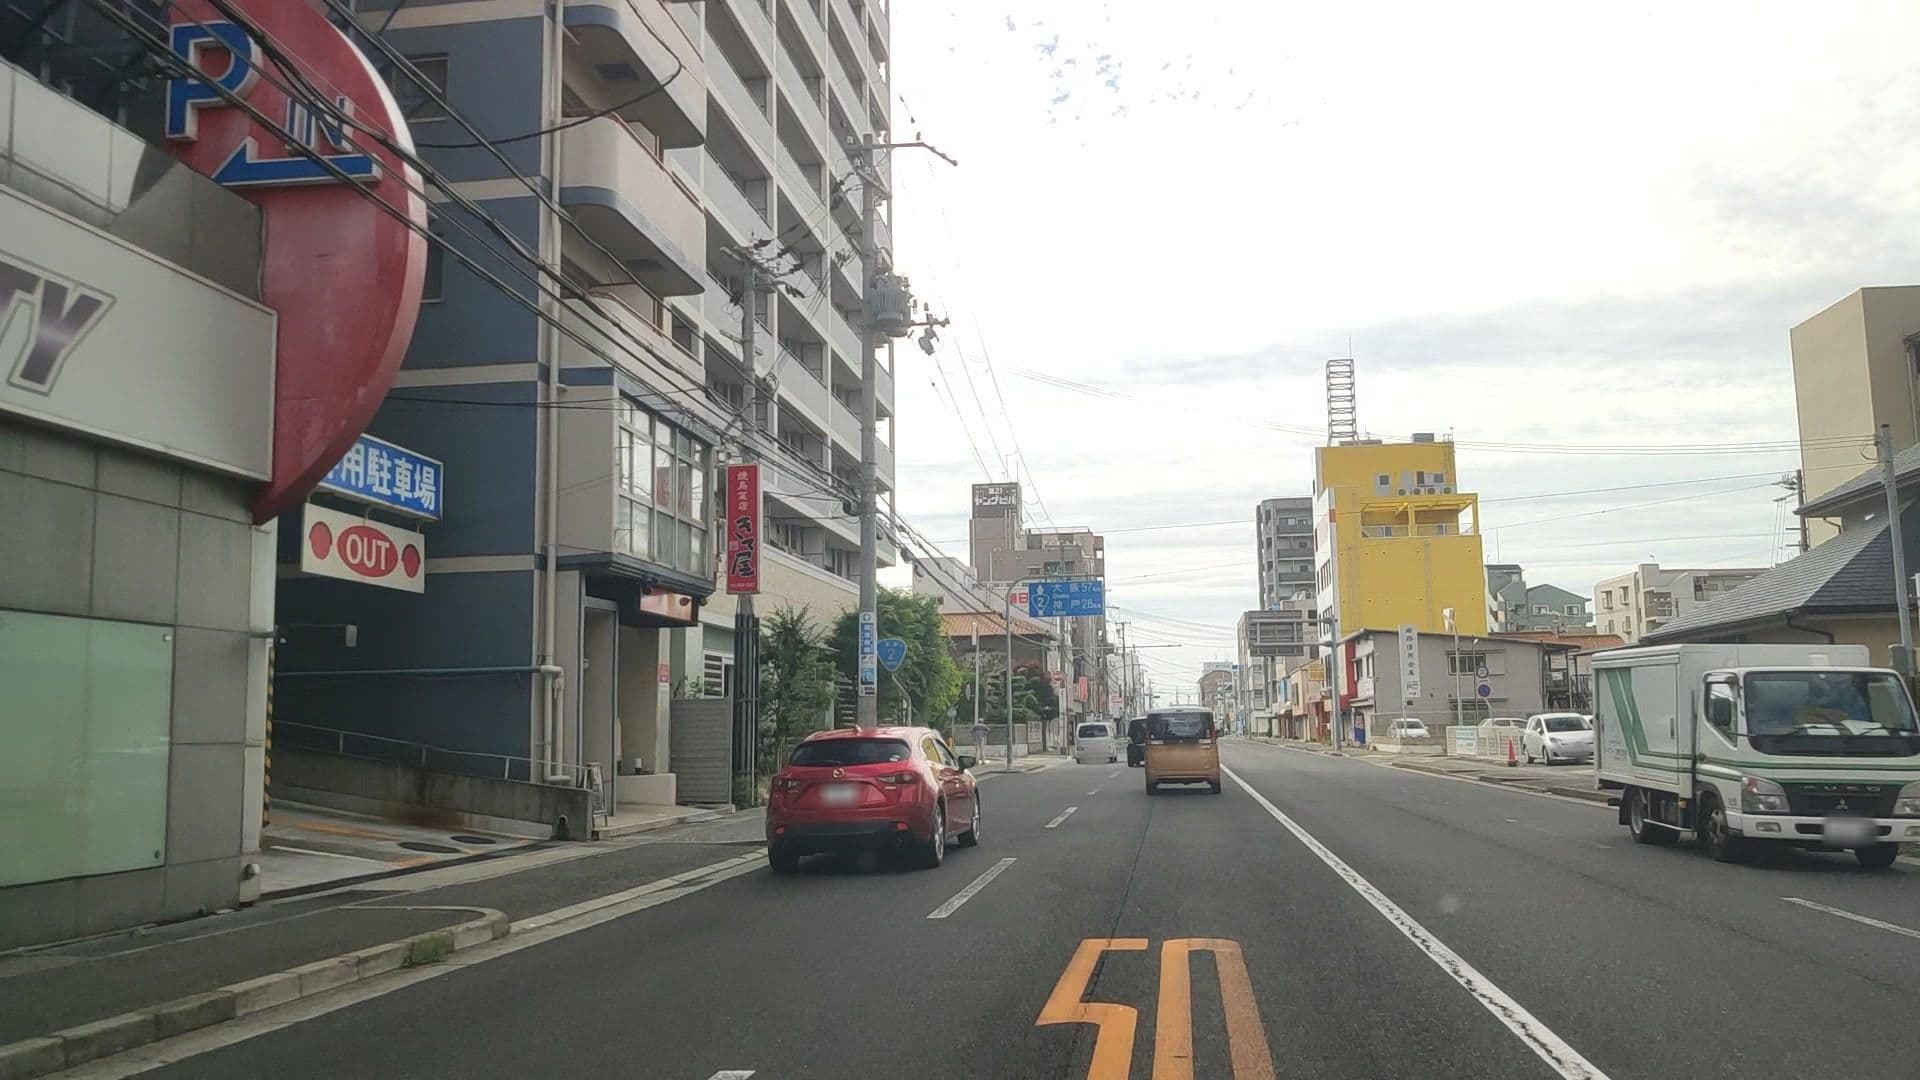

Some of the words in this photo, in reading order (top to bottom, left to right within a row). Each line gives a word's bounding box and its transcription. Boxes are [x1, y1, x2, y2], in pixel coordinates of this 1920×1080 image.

[166, 20, 262, 141] P
[285, 95, 355, 152] IN
[346, 533, 390, 570] OUT
[1037, 597, 1044, 608] 2
[1033, 937, 1276, 1080] 50
